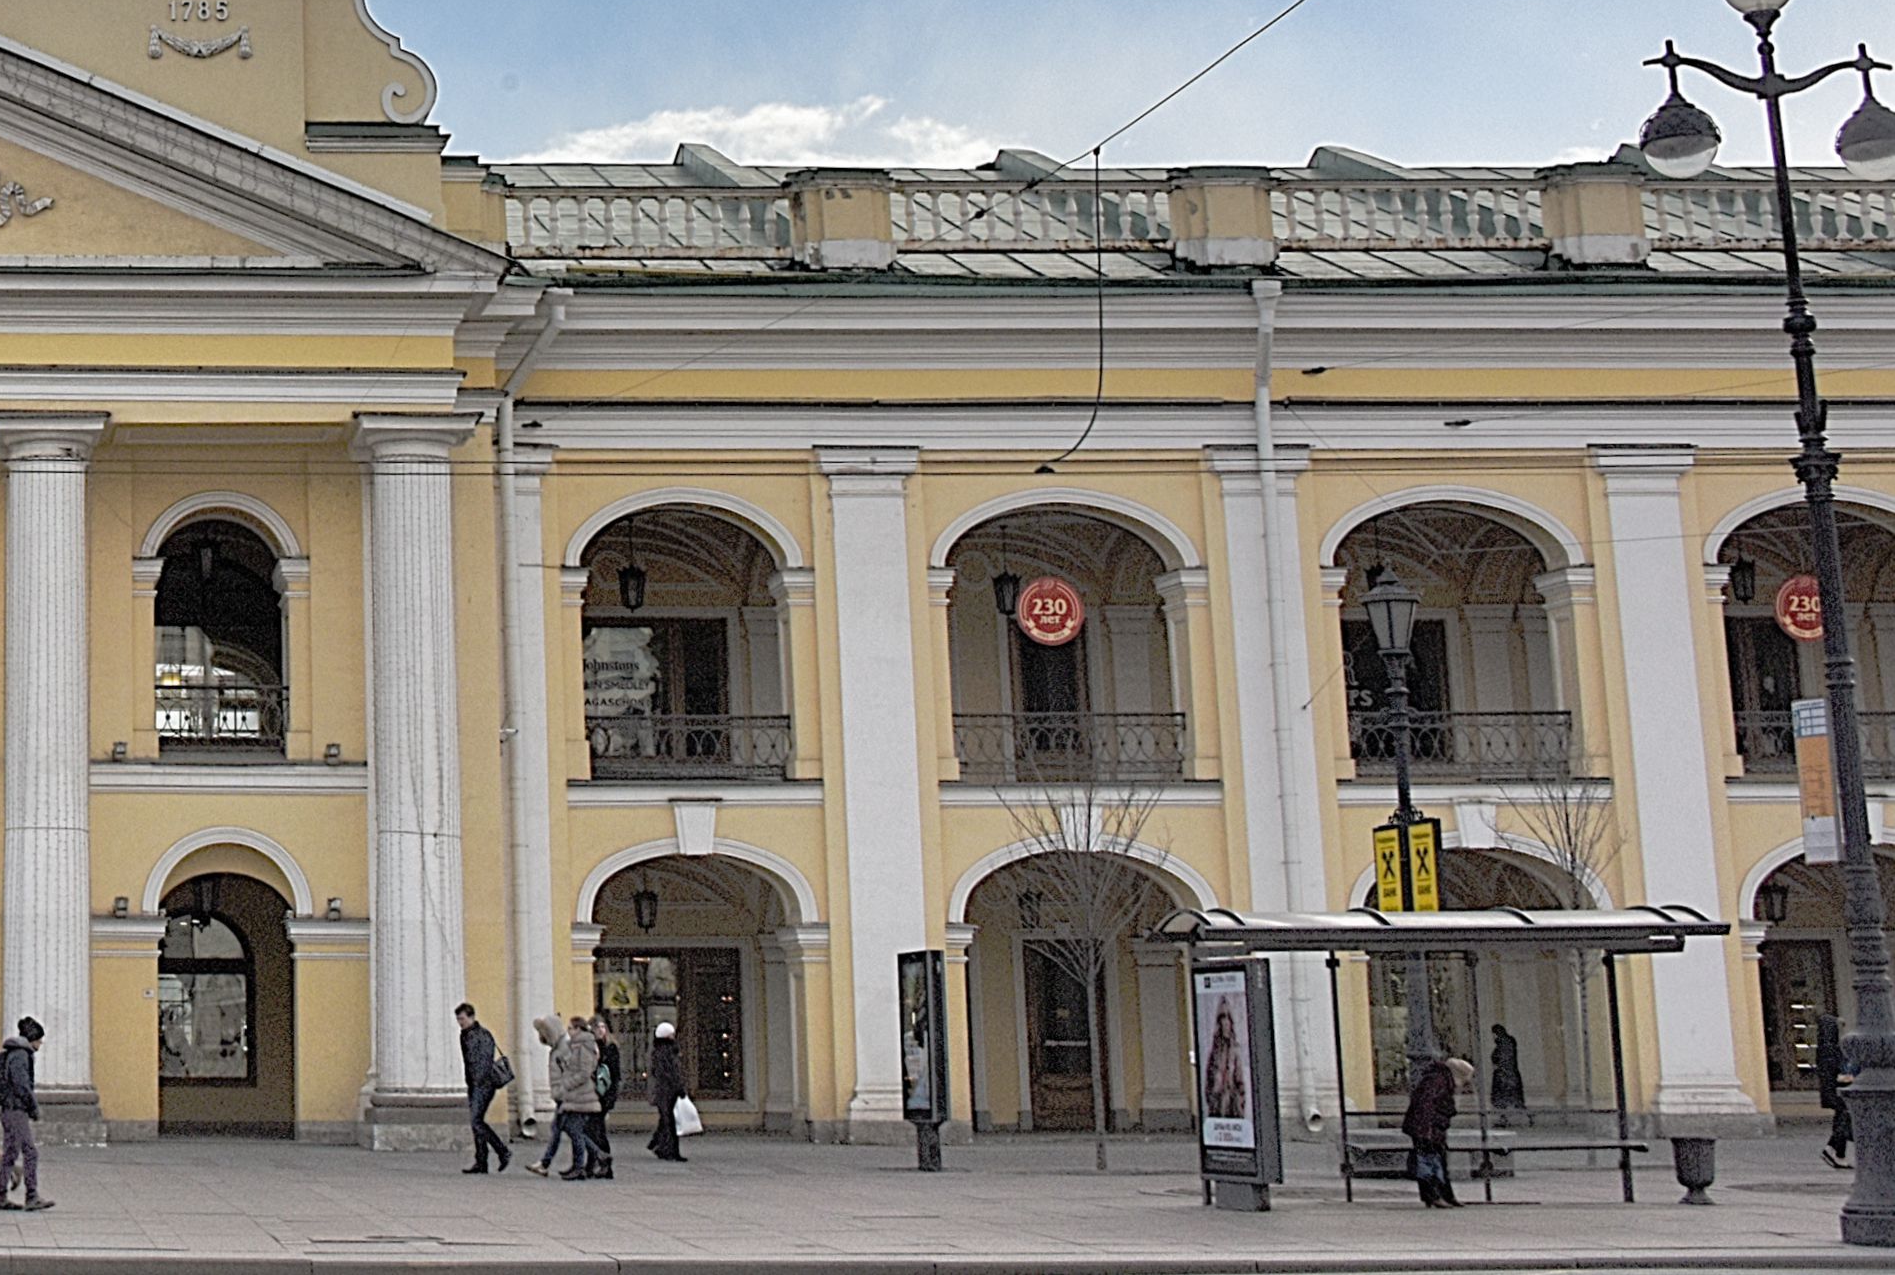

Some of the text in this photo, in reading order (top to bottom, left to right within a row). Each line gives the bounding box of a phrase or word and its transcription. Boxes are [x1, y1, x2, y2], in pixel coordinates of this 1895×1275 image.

[168, 0, 229, 22] 1785
[1031, 598, 1068, 615] 230
[1788, 595, 1821, 612] 230
[1039, 615, 1061, 624] лет
[583, 658, 640, 673] Johnstons
